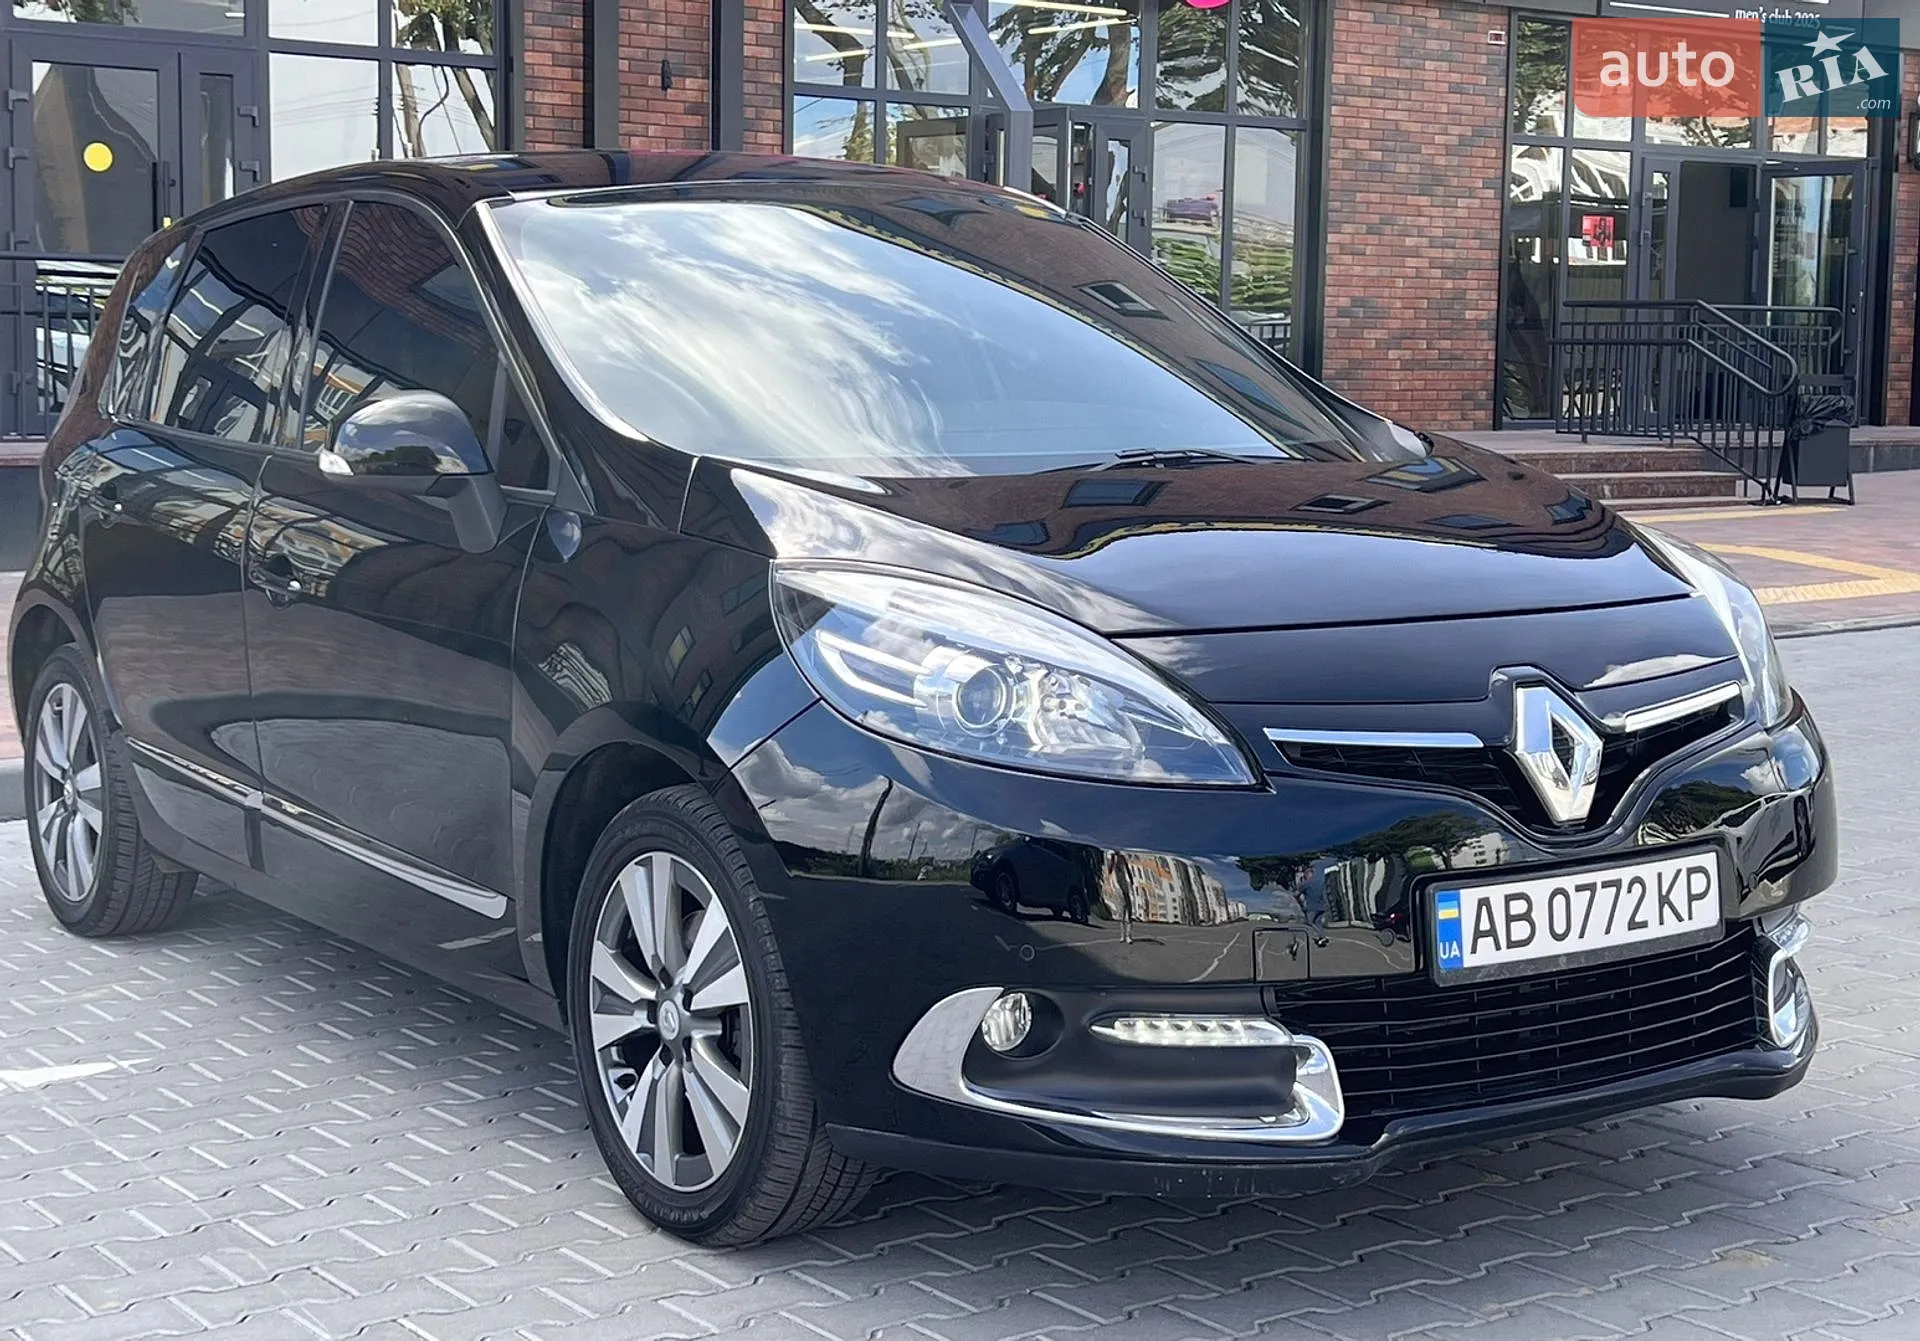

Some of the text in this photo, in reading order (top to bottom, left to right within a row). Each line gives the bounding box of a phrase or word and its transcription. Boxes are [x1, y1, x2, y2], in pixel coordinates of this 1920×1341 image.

[1735, 6, 1821, 29] men's club 2025
[1470, 865, 1712, 954] AB 0772 KP
[1439, 941, 1461, 959] UA
